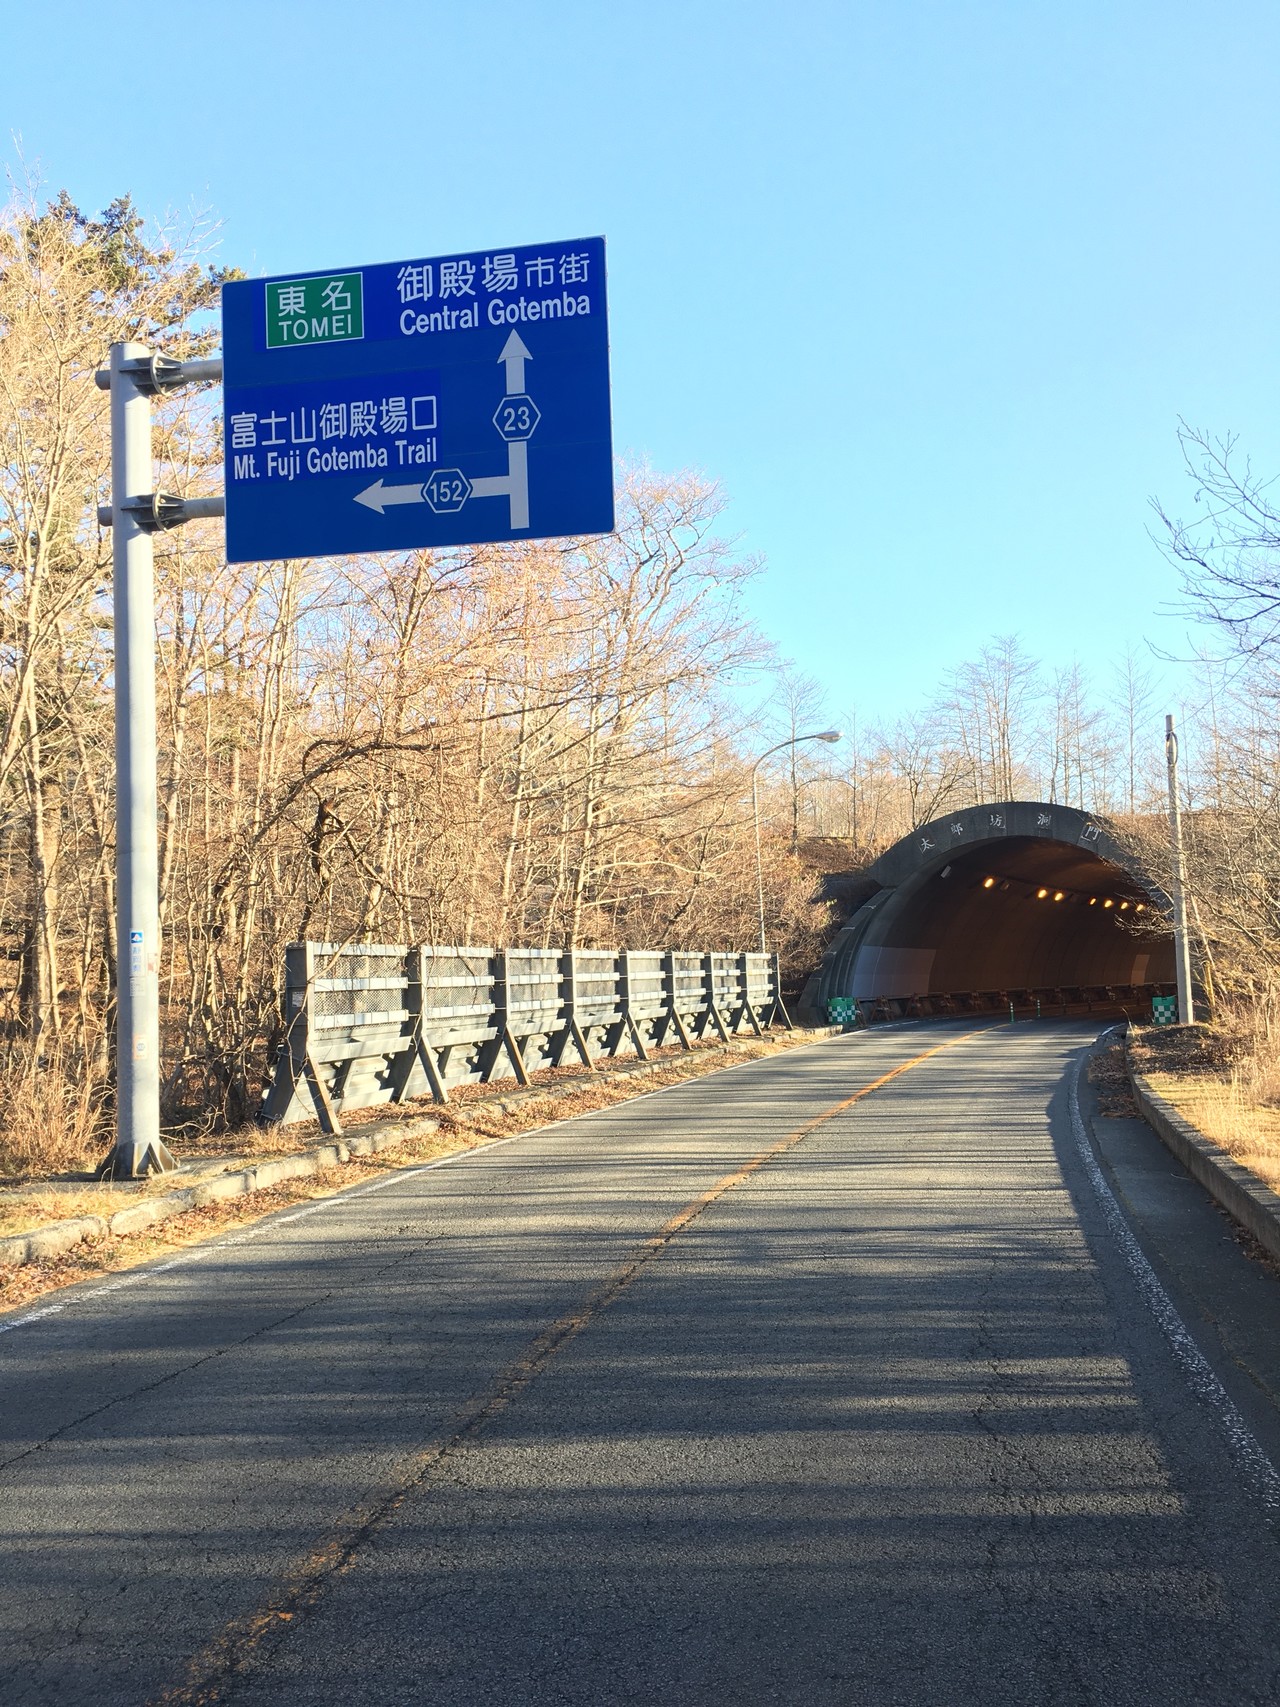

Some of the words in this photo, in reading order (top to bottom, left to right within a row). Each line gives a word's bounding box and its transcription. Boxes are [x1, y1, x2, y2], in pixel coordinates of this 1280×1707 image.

[397, 252, 590, 303] 御殿場市街
[277, 281, 352, 316] 東名
[400, 303, 478, 335] Central
[488, 292, 590, 325] Gotemba
[279, 314, 352, 341] TOMEI
[231, 396, 437, 449] 富士山御殿場口
[503, 406, 530, 432] 23
[234, 454, 261, 480] Mt.
[267, 450, 300, 481] Fuji
[306, 443, 388, 474] Gotemba
[394, 437, 437, 465] Trail
[430, 481, 463, 502] 152
